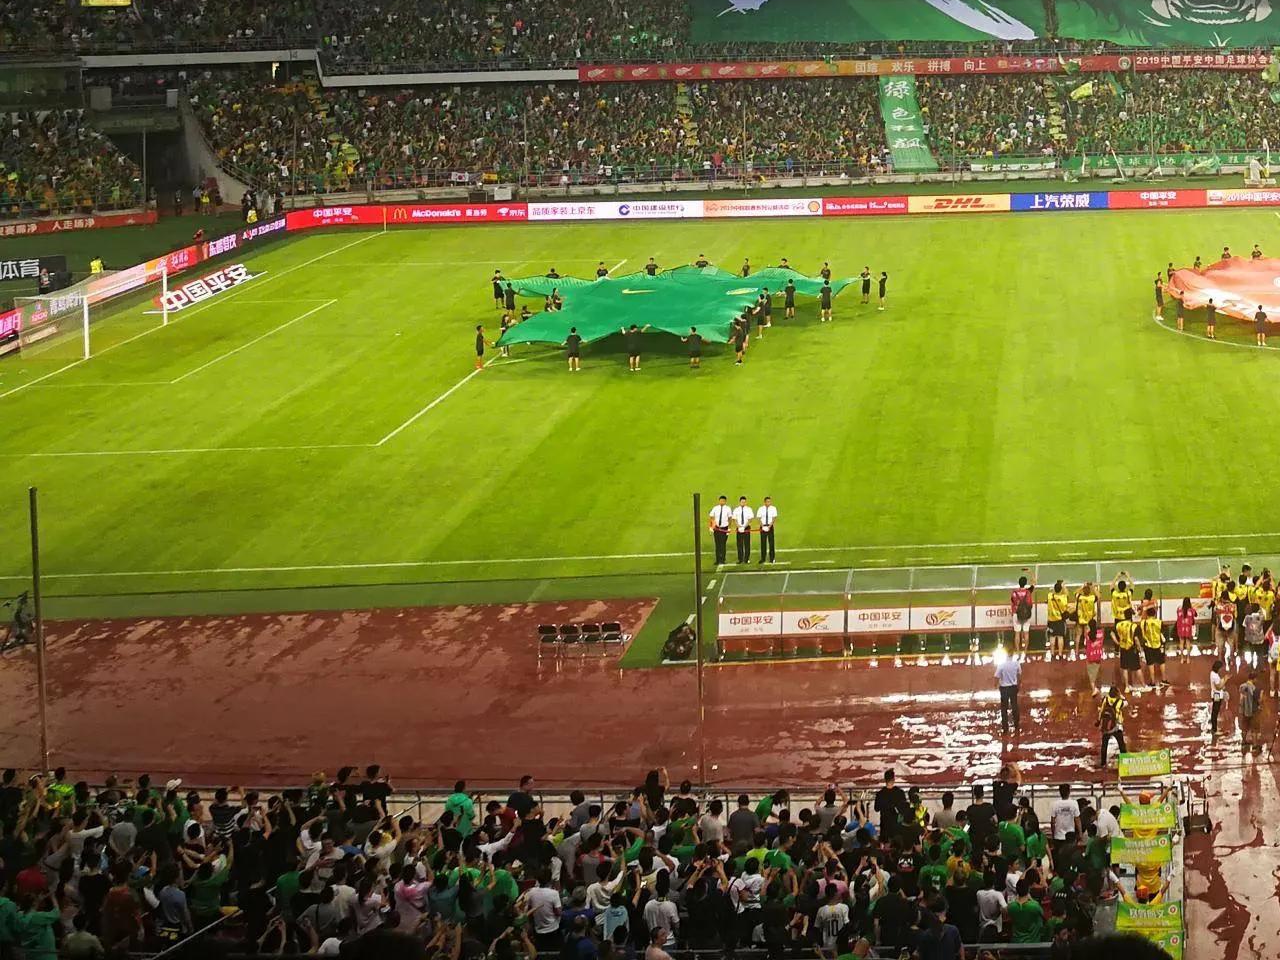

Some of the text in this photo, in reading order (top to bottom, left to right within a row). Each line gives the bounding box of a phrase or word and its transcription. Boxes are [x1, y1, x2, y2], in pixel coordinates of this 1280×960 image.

[963, 59, 987, 71] 向上
[934, 198, 985, 209] DHL
[1030, 194, 1090, 208] 上汽荣威
[412, 209, 461, 218] McDonald's
[0, 259, 39, 280] 体育
[160, 264, 253, 310] 中国平安
[730, 615, 773, 625] 中国平安
[859, 611, 901, 621] 中国平安
